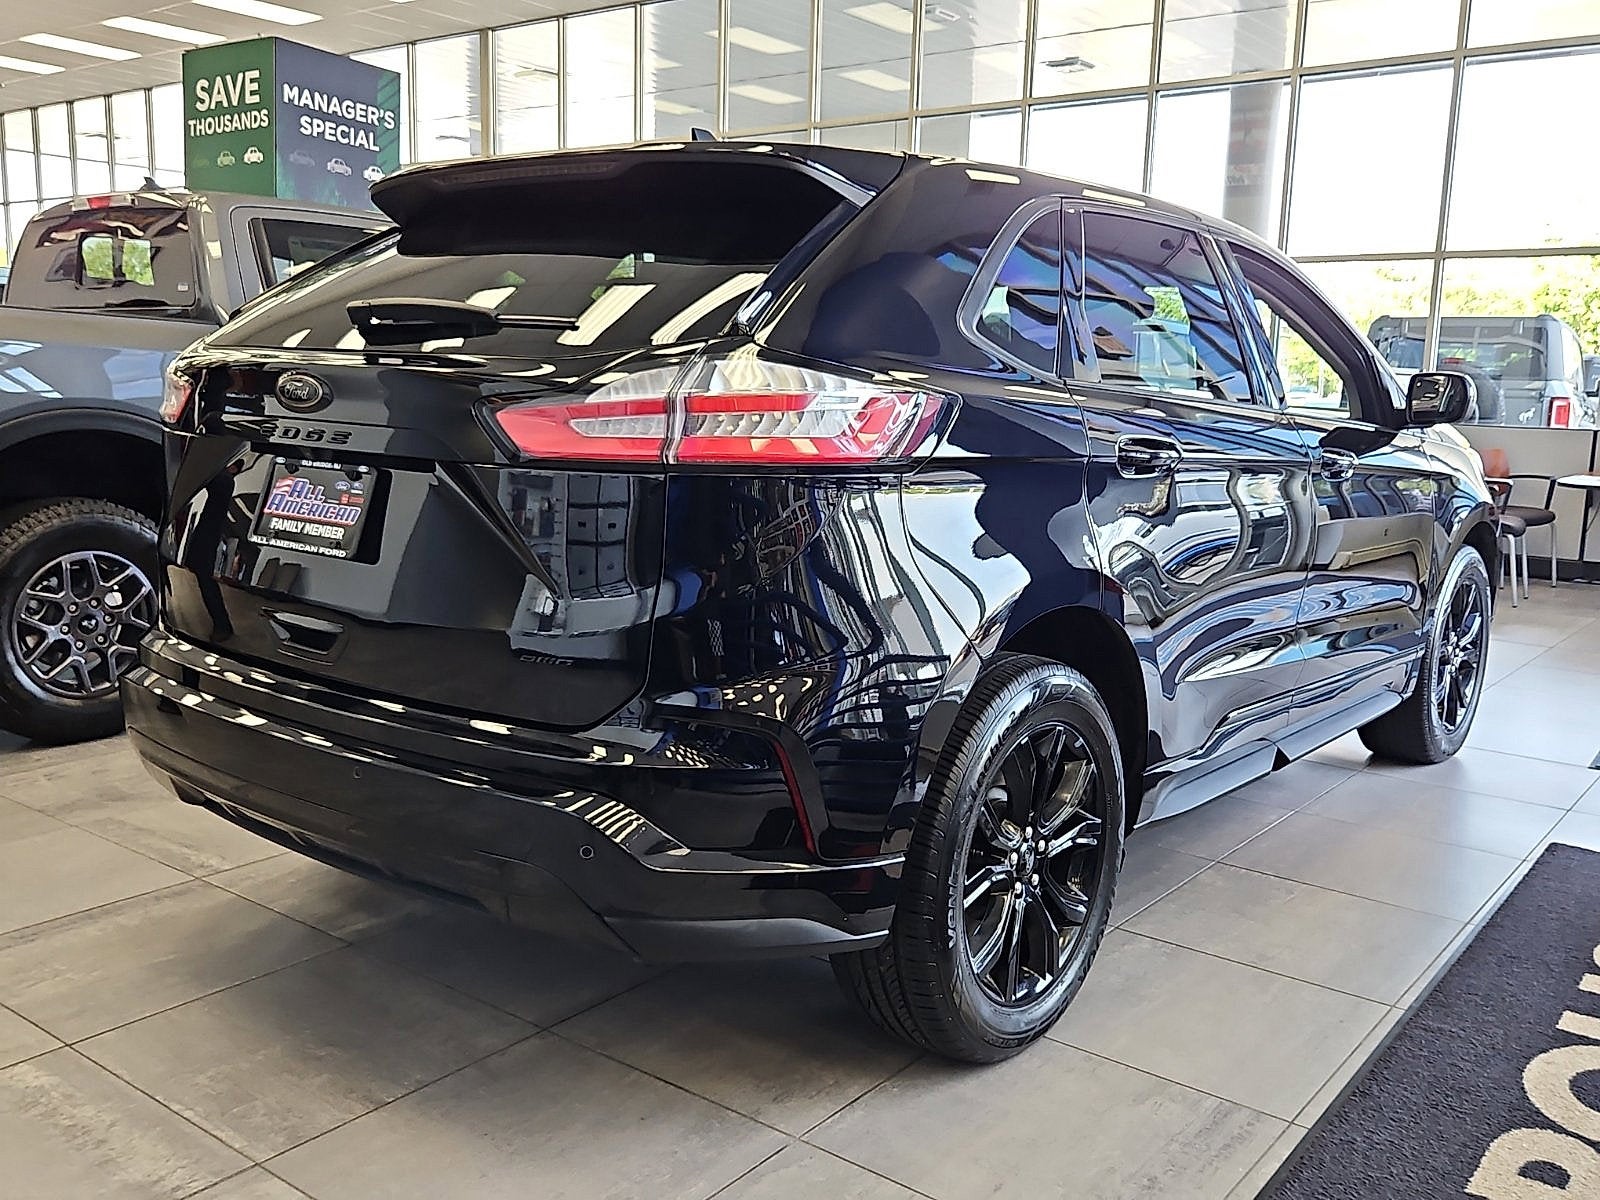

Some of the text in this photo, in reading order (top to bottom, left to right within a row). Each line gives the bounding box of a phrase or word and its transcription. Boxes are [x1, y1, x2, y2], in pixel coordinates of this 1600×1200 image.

[195, 69, 260, 111] SAVE
[283, 83, 395, 130] MANAGER'S
[188, 108, 269, 137] THOUSANDS
[300, 115, 380, 152] SPECIAL
[284, 381, 310, 399] Ford
[260, 422, 352, 445] EDGE
[270, 518, 345, 540] FAMILY MEMBER
[251, 535, 347, 558] ALL AMERICAN FORD
